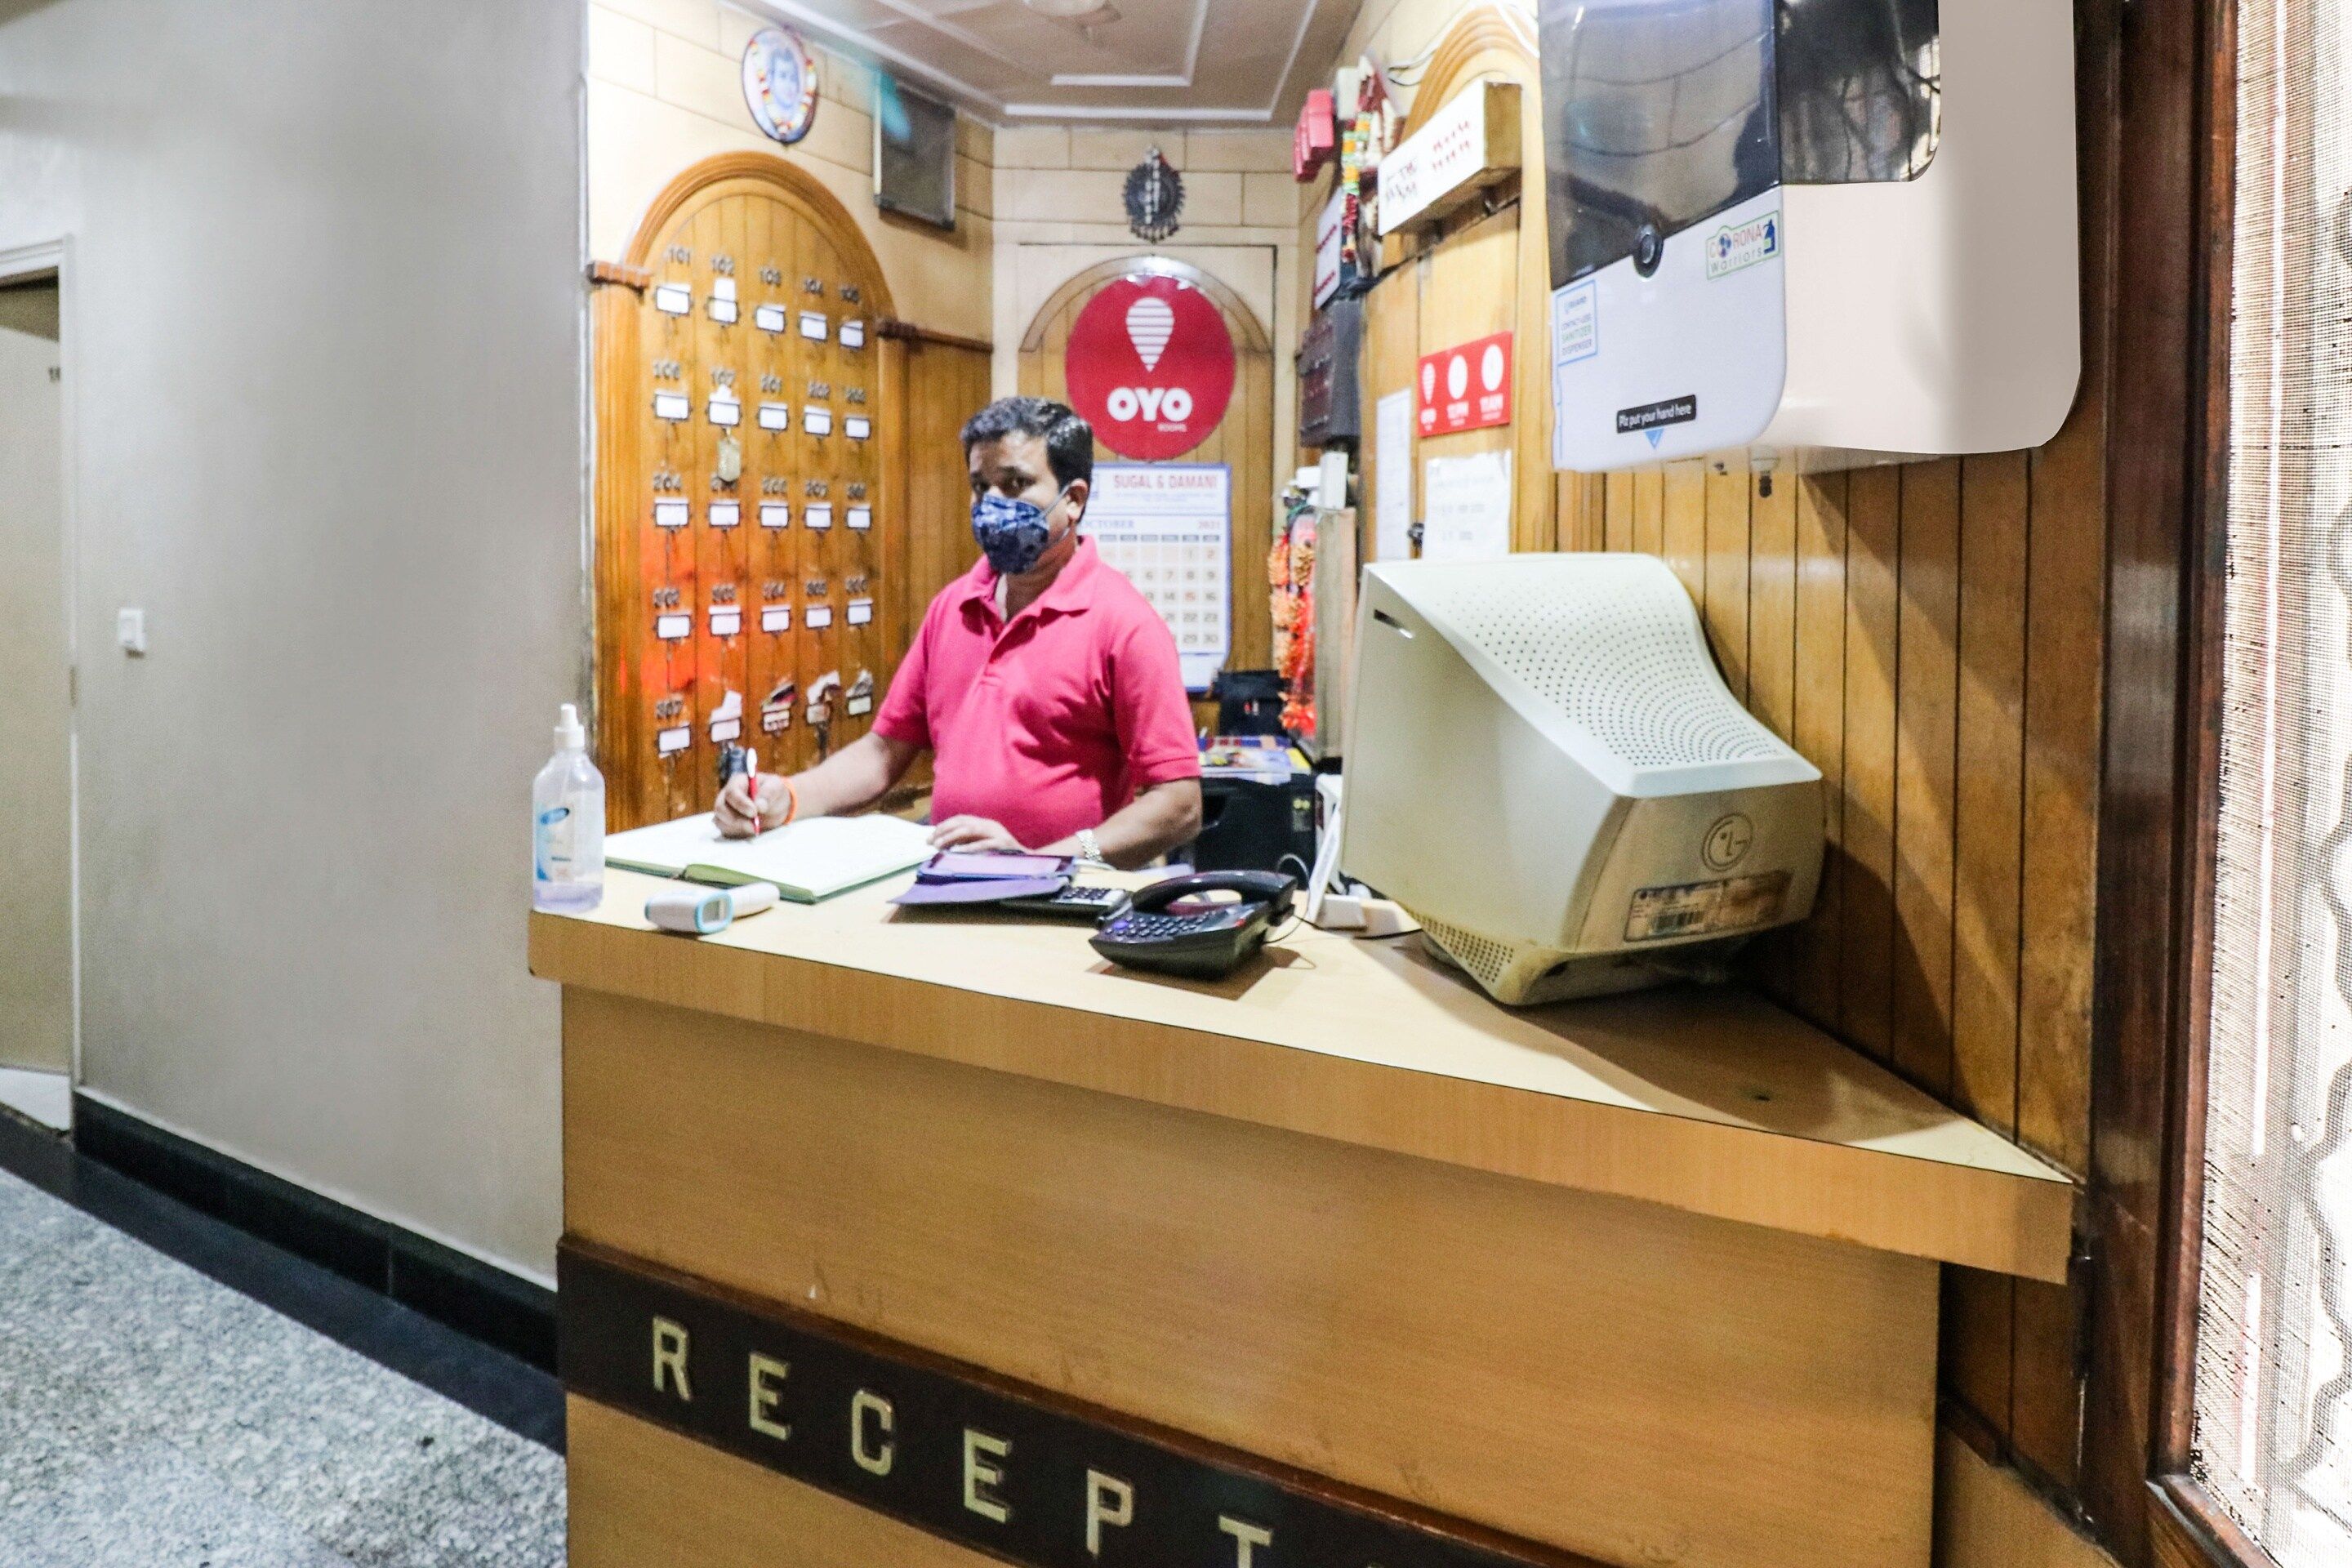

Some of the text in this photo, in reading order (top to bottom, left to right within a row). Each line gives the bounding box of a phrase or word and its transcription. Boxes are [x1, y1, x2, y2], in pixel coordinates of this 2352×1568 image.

[668, 246, 691, 266] 101
[1711, 247, 1763, 274] Warriors
[1107, 387, 1193, 421] OYO
[1114, 474, 1217, 488] SUGAL & DAMANI
[653, 1316, 1383, 1568] RECEPT
